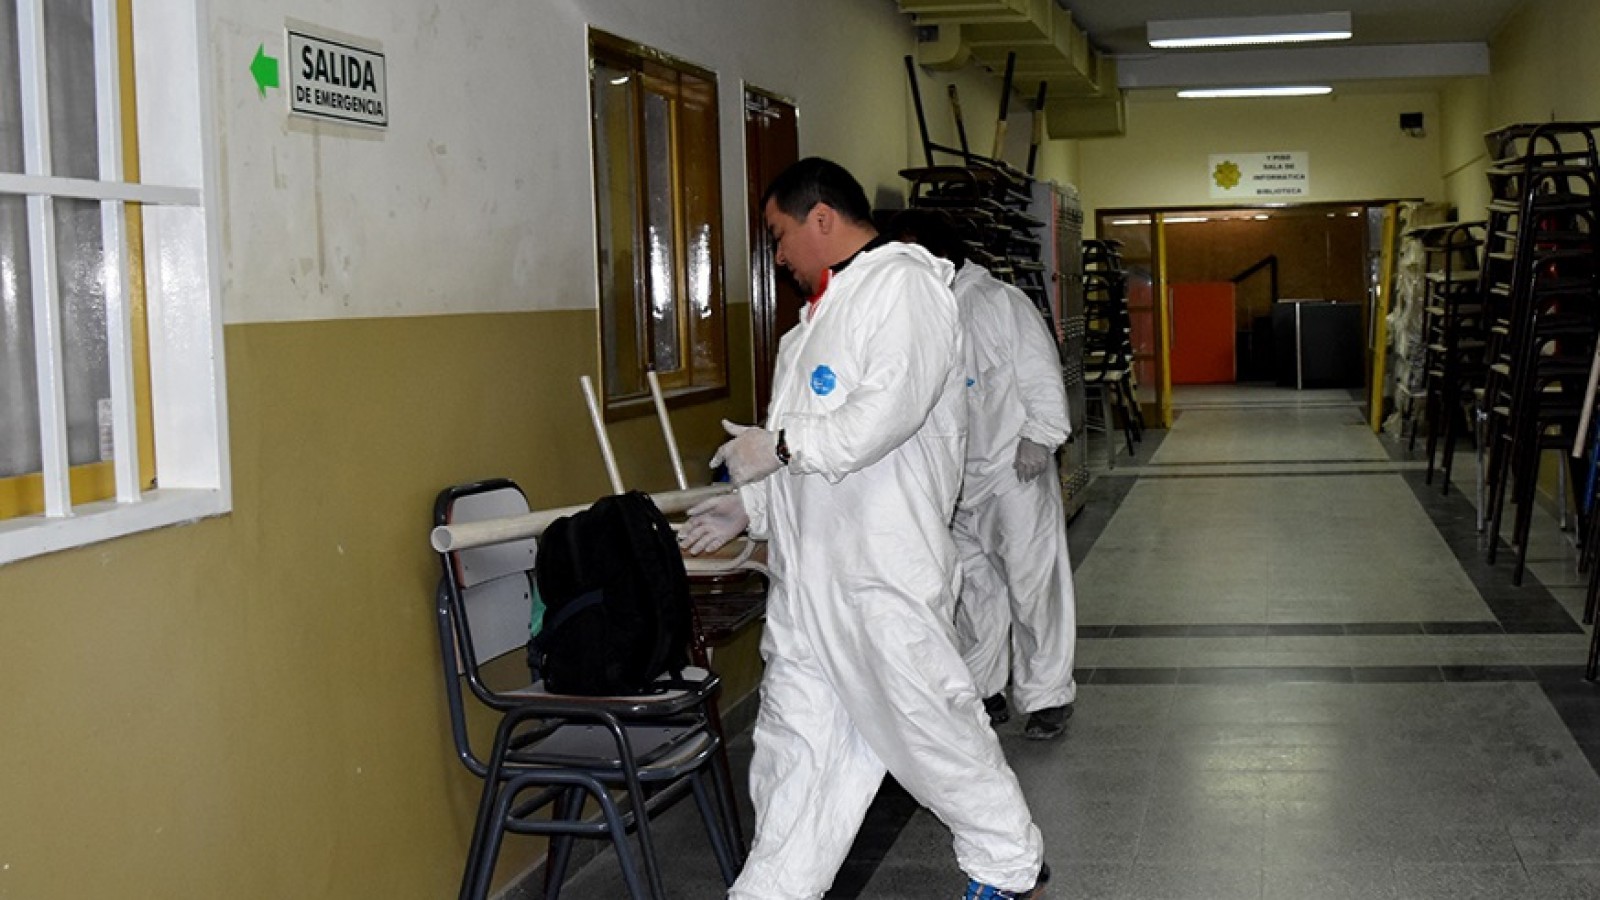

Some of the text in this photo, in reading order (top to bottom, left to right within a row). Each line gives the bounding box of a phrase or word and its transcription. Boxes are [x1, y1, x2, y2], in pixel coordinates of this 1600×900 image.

[301, 44, 377, 93] SALIDA
[296, 85, 384, 116] DE EMERGENCIA
